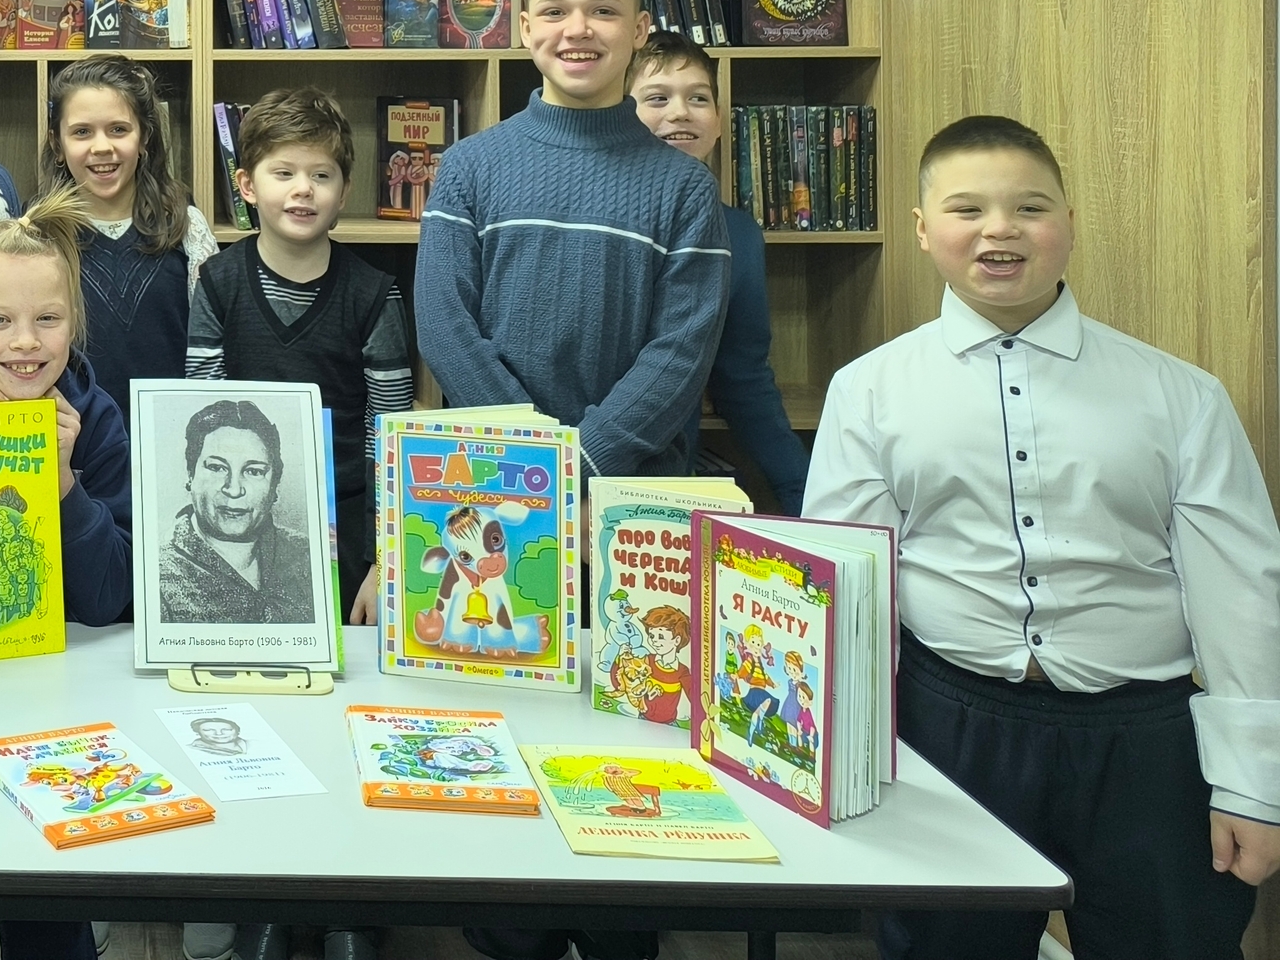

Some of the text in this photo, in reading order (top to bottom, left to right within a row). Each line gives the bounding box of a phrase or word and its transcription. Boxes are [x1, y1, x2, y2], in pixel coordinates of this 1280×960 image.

[391, 110, 440, 122] ПОДЗЕМНЫЙ
[403, 124, 430, 139] МИР
[457, 441, 505, 456] АГНИЯ
[408, 453, 551, 493] БАРТО
[620, 490, 722, 509] БИБЛИОТЕКА ШКОЛЬНИКА
[625, 504, 666, 518] Агния
[613, 549, 691, 575] ЧЕРЕПА
[736, 561, 798, 580] ЛЮБИМЫЕ СТИХИ
[741, 578, 800, 611] Агния Барто
[732, 592, 809, 639] Я РАСТУ
[159, 636, 186, 647] Агния
[188, 636, 226, 648] Львовна
[228, 636, 254, 648] Барто
[257, 636, 282, 648] (1906
[292, 636, 318, 648] 1981)
[702, 584, 710, 685] ДЕТСКАЯ БИБЛИОТЕКА
[472, 666, 494, 676] Омега
[384, 707, 471, 718] АГНИЯ БАРТО
[5, 727, 86, 745] АГНИЯ БАРТО
[199, 756, 282, 767] Агния Львовна
[228, 764, 262, 772] Барто
[577, 826, 752, 841] ДЕВОЧКА РЁВУШКА
